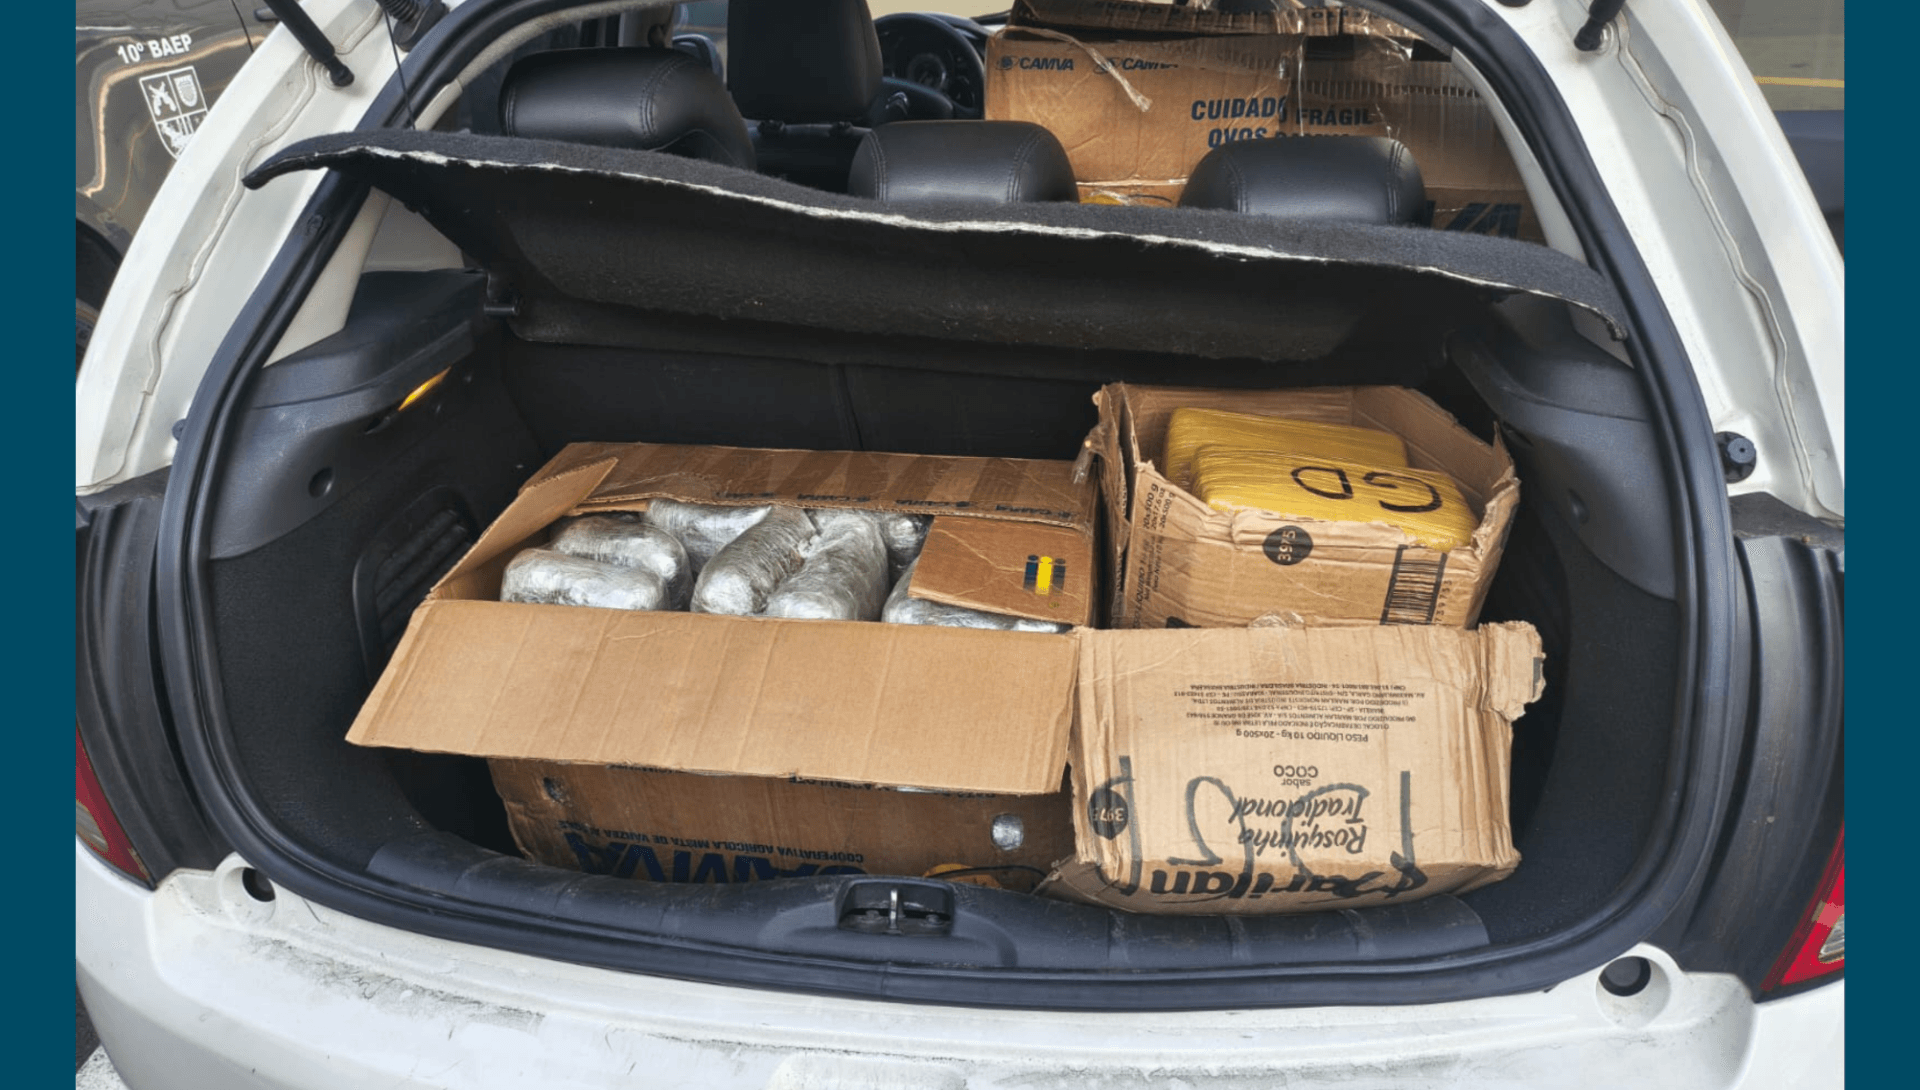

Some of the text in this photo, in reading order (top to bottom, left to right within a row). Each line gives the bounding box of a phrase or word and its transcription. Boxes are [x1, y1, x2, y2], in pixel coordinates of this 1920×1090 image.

[149, 33, 193, 59] BAEP
[1019, 57, 1074, 71] CAMVA
[1296, 106, 1373, 126] FRÁGIL
[1150, 483, 1159, 493] g
[1277, 530, 1296, 562] 3975
[1236, 729, 1242, 738] g
[1244, 730, 1274, 738] 20x500
[1282, 730, 1292, 739] kg
[1307, 732, 1343, 743] LÍQUIDO
[1345, 734, 1368, 742] PESO
[1273, 765, 1318, 778] COCO
[1281, 778, 1311, 788] sabor
[1228, 797, 1364, 827] Tradicional
[652, 834, 669, 846] DE
[670, 836, 710, 850] MISTA
[1238, 824, 1367, 858] Rosquinha
[712, 841, 774, 856] AGRÍCOLA
[776, 846, 864, 864] COOPERATIVA
